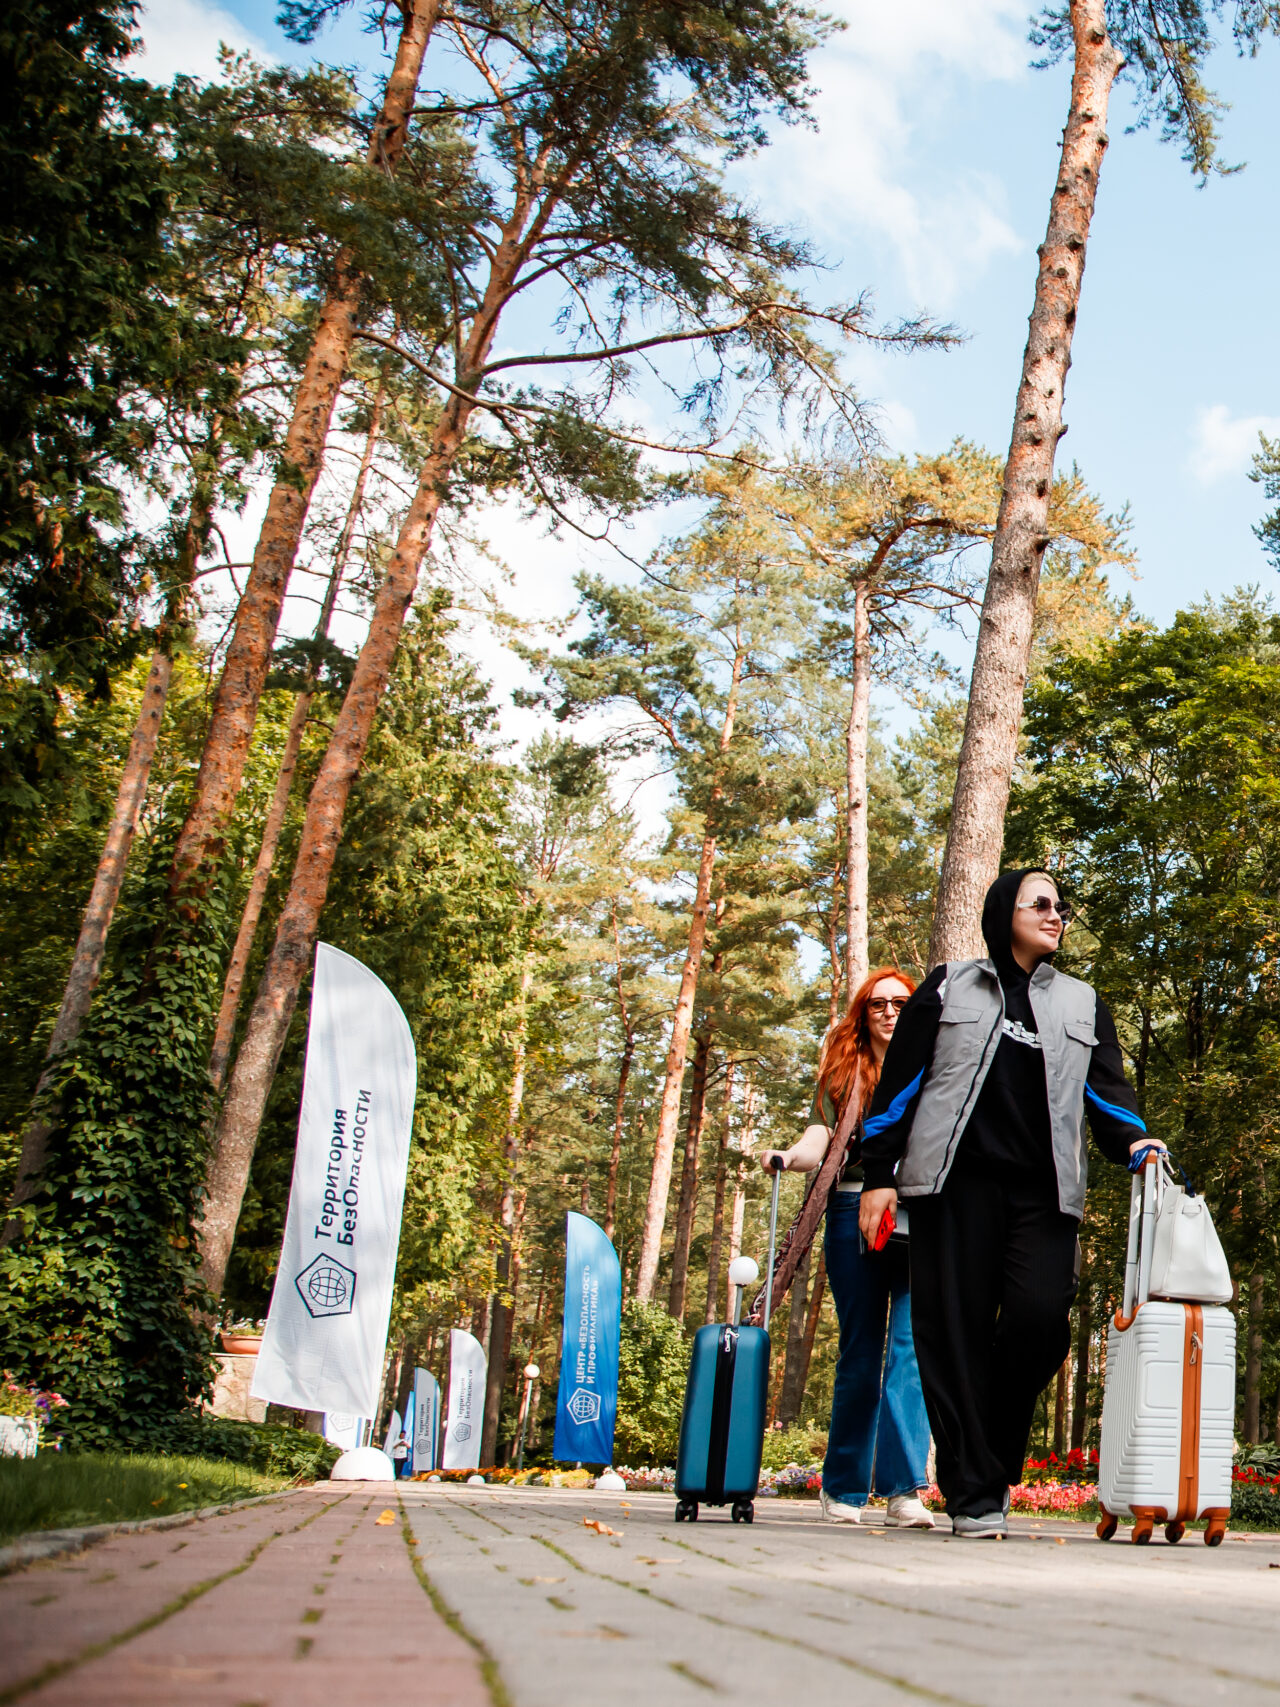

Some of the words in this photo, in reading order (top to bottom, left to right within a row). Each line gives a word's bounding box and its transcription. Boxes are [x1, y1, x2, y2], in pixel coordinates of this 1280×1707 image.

[314, 1108, 349, 1240] Территория
[337, 1089, 372, 1246] БезОпасности
[579, 1266, 591, 1348] «БЕЗОПАСНОСТЬ
[587, 1280, 599, 1373] ПРОФИЛАКТИКА»
[576, 1351, 586, 1383] ЦЕНТР
[587, 1376, 596, 1384] И
